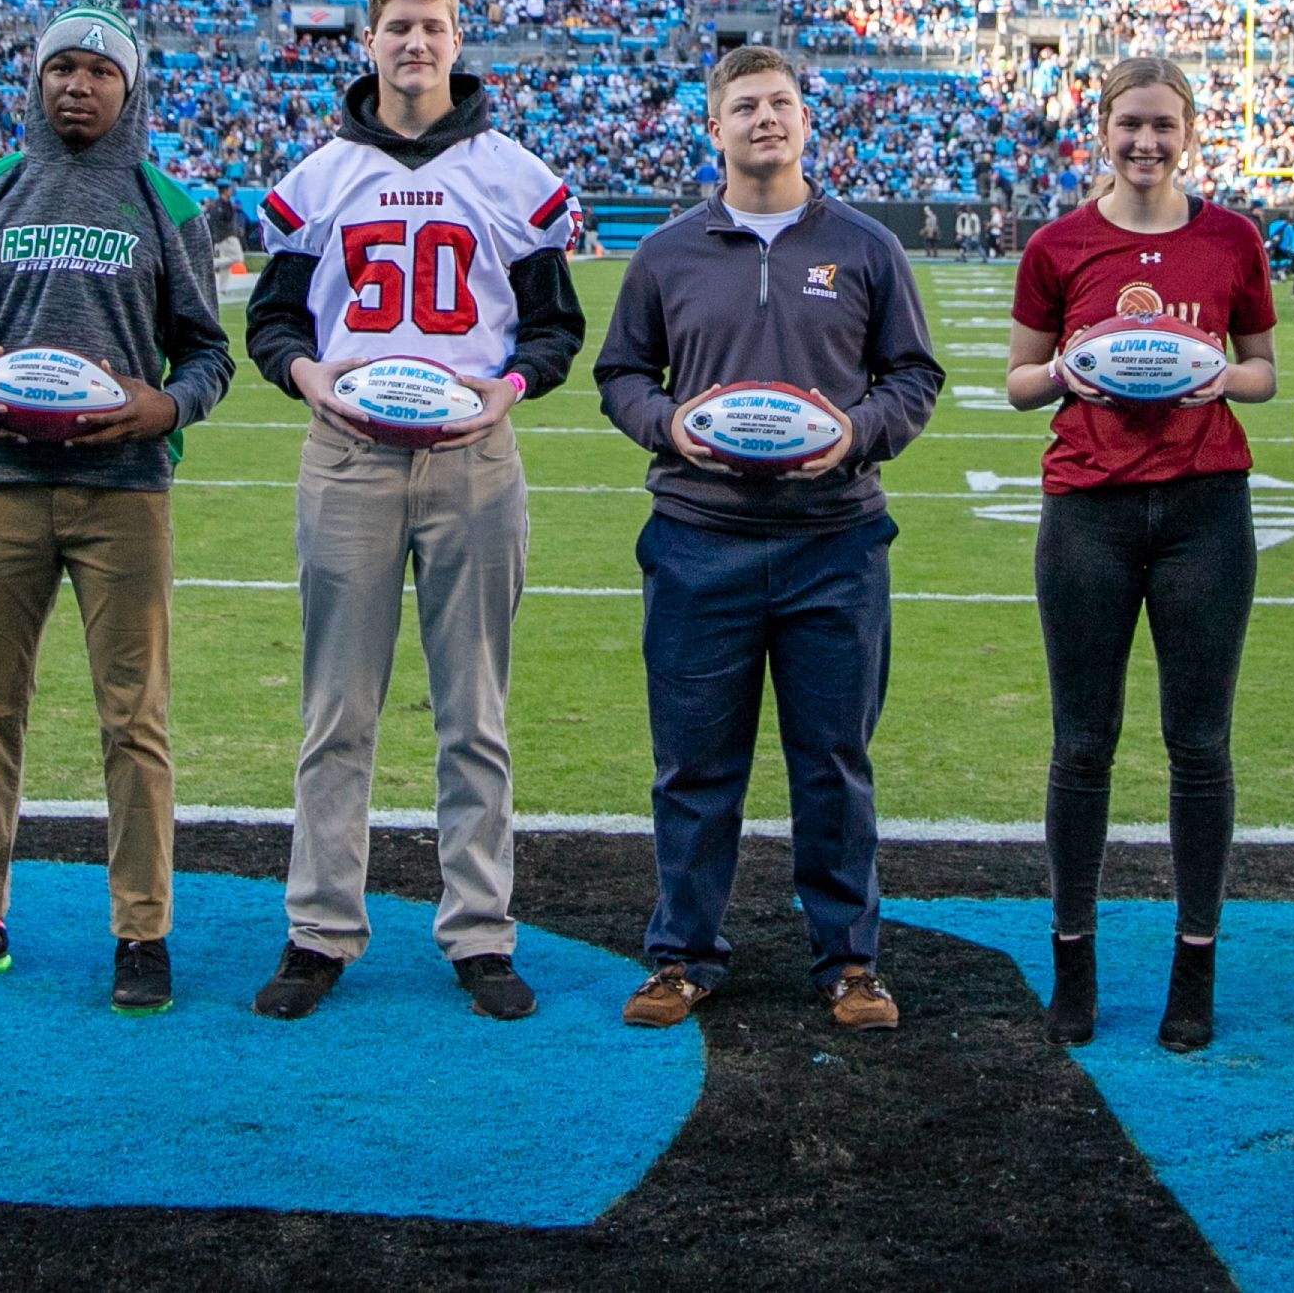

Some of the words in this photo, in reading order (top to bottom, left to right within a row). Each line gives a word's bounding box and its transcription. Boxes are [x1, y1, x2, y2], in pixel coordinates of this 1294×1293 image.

[80, 23, 106, 51] A
[380, 191, 444, 206] RAIDERS
[1, 224, 139, 268] ASHBROOK
[341, 220, 478, 335] 50
[807, 267, 830, 285] H
[803, 286, 837, 299] LACROSSE
[1110, 339, 1146, 353] OLIVIA
[1149, 339, 1180, 354] PISEL
[369, 366, 399, 377] COLIN
[24, 388, 56, 401] 2019
[1127, 383, 1162, 393] 2019
[385, 406, 417, 419] 2019
[741, 438, 774, 451] 2019
